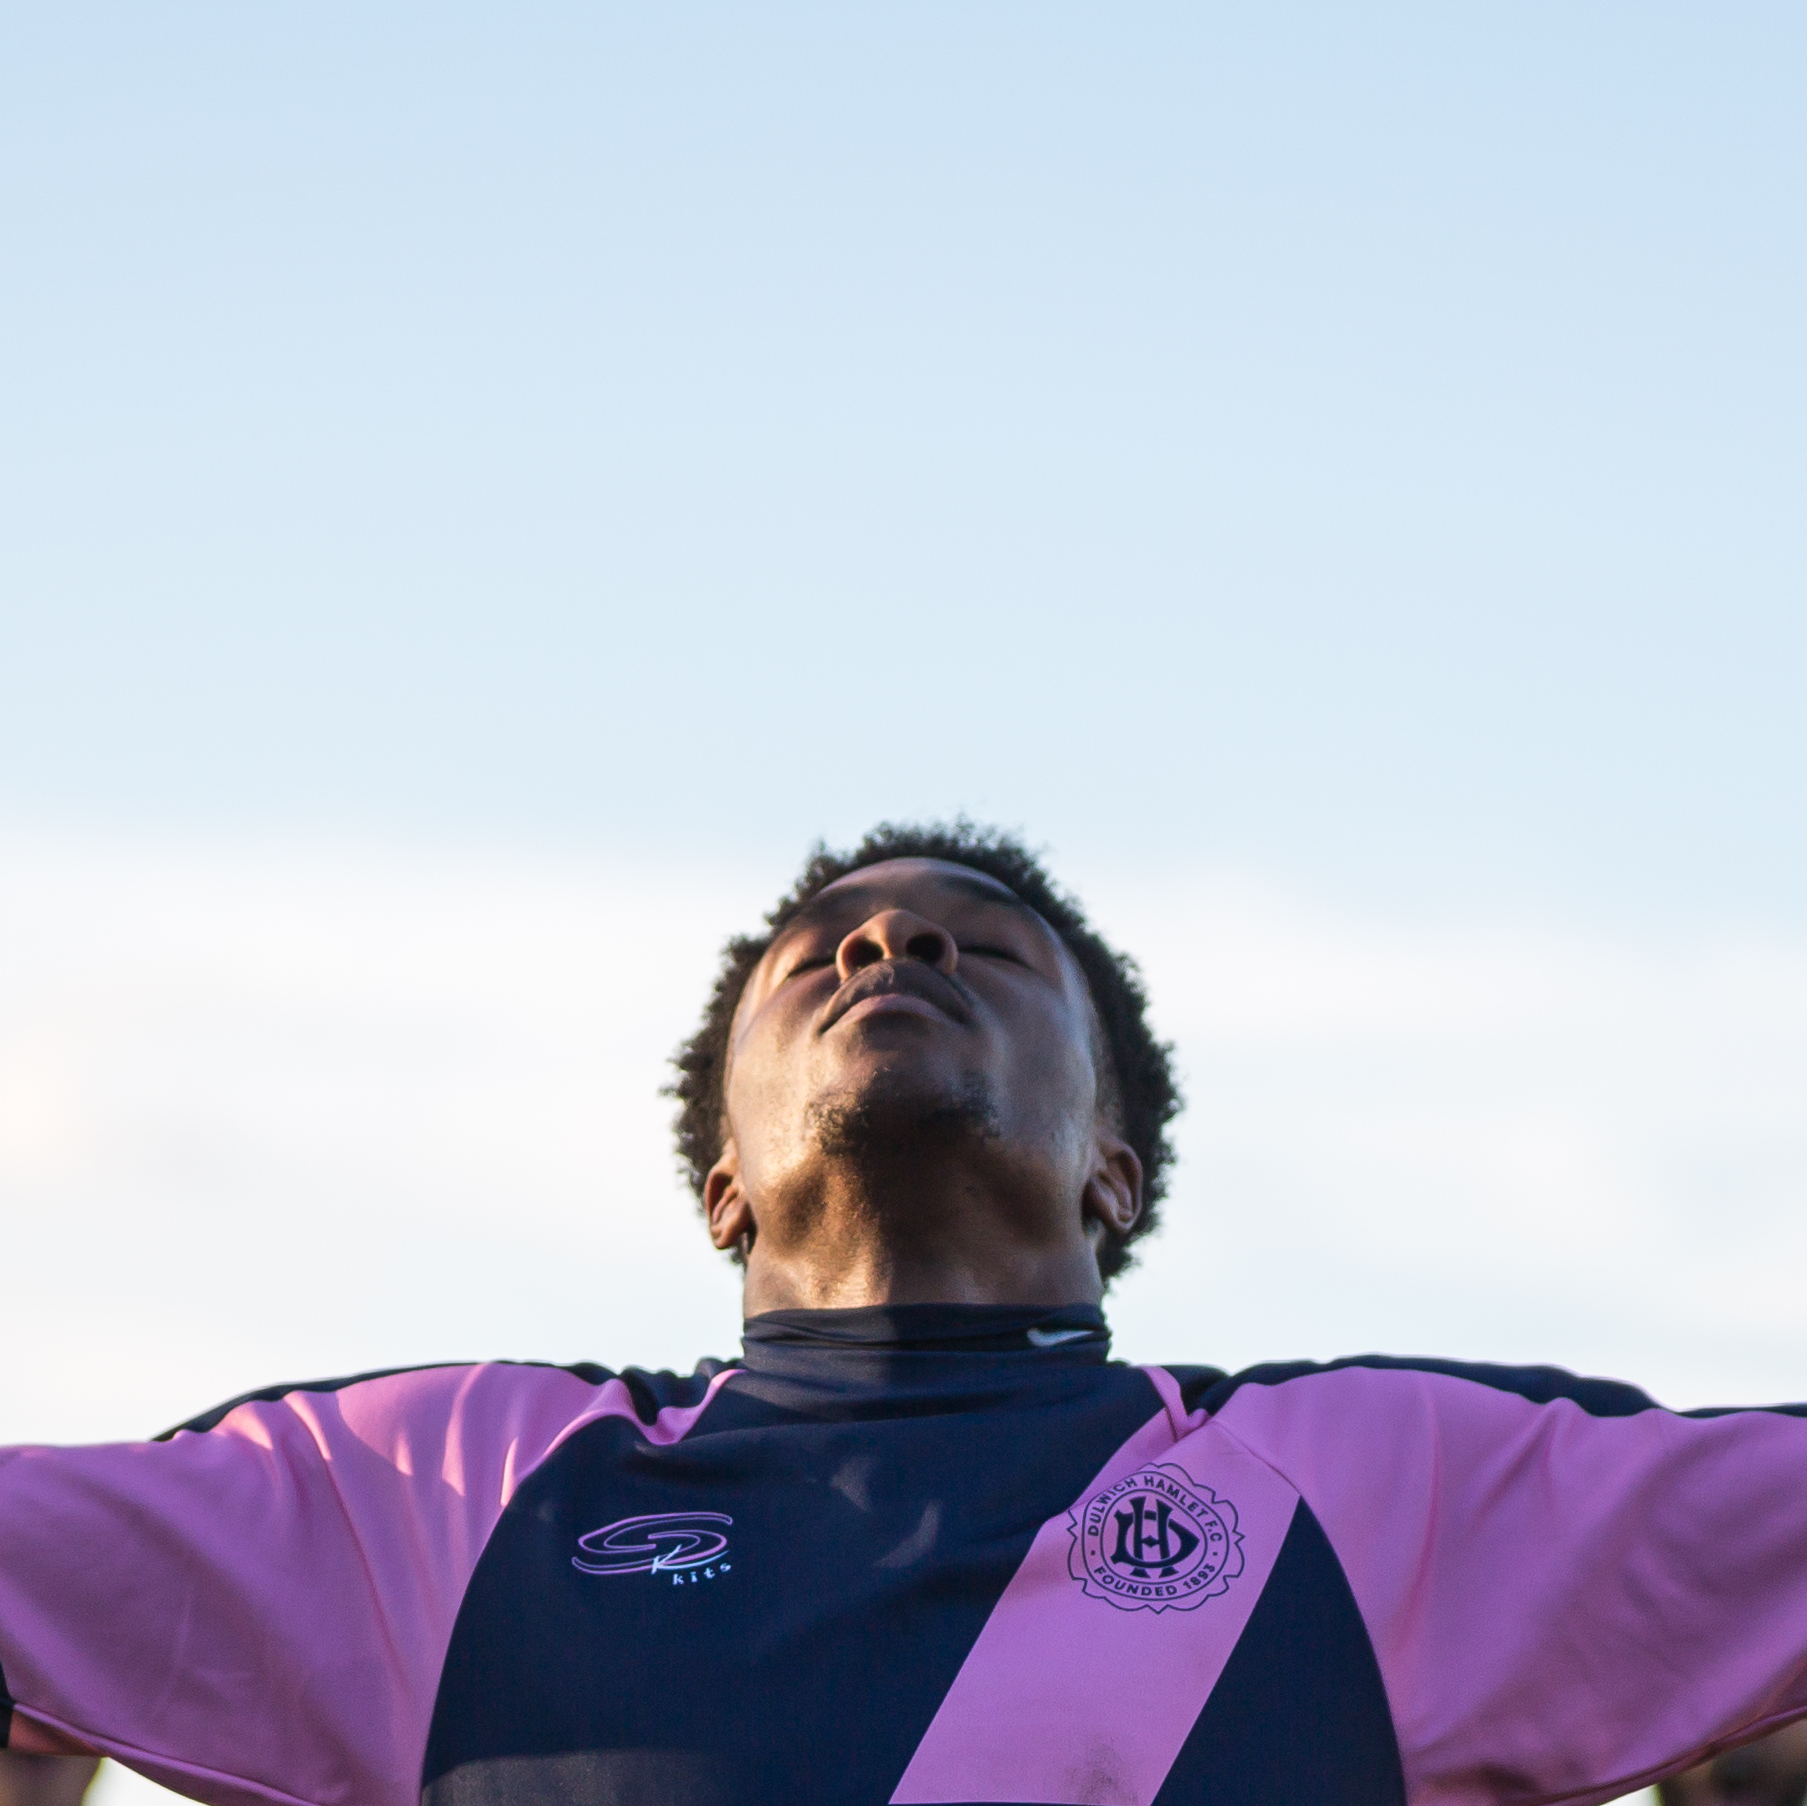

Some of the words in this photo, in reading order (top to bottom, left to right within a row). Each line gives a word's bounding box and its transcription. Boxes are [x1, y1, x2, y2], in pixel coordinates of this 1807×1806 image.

[1088, 1476, 1138, 1537] DULWICH
[1144, 1475, 1208, 1518] HAMLET
[672, 1562, 732, 1586] kits
[1094, 1565, 1177, 1597] FOUNDED
[1183, 1563, 1216, 1590] 1893
